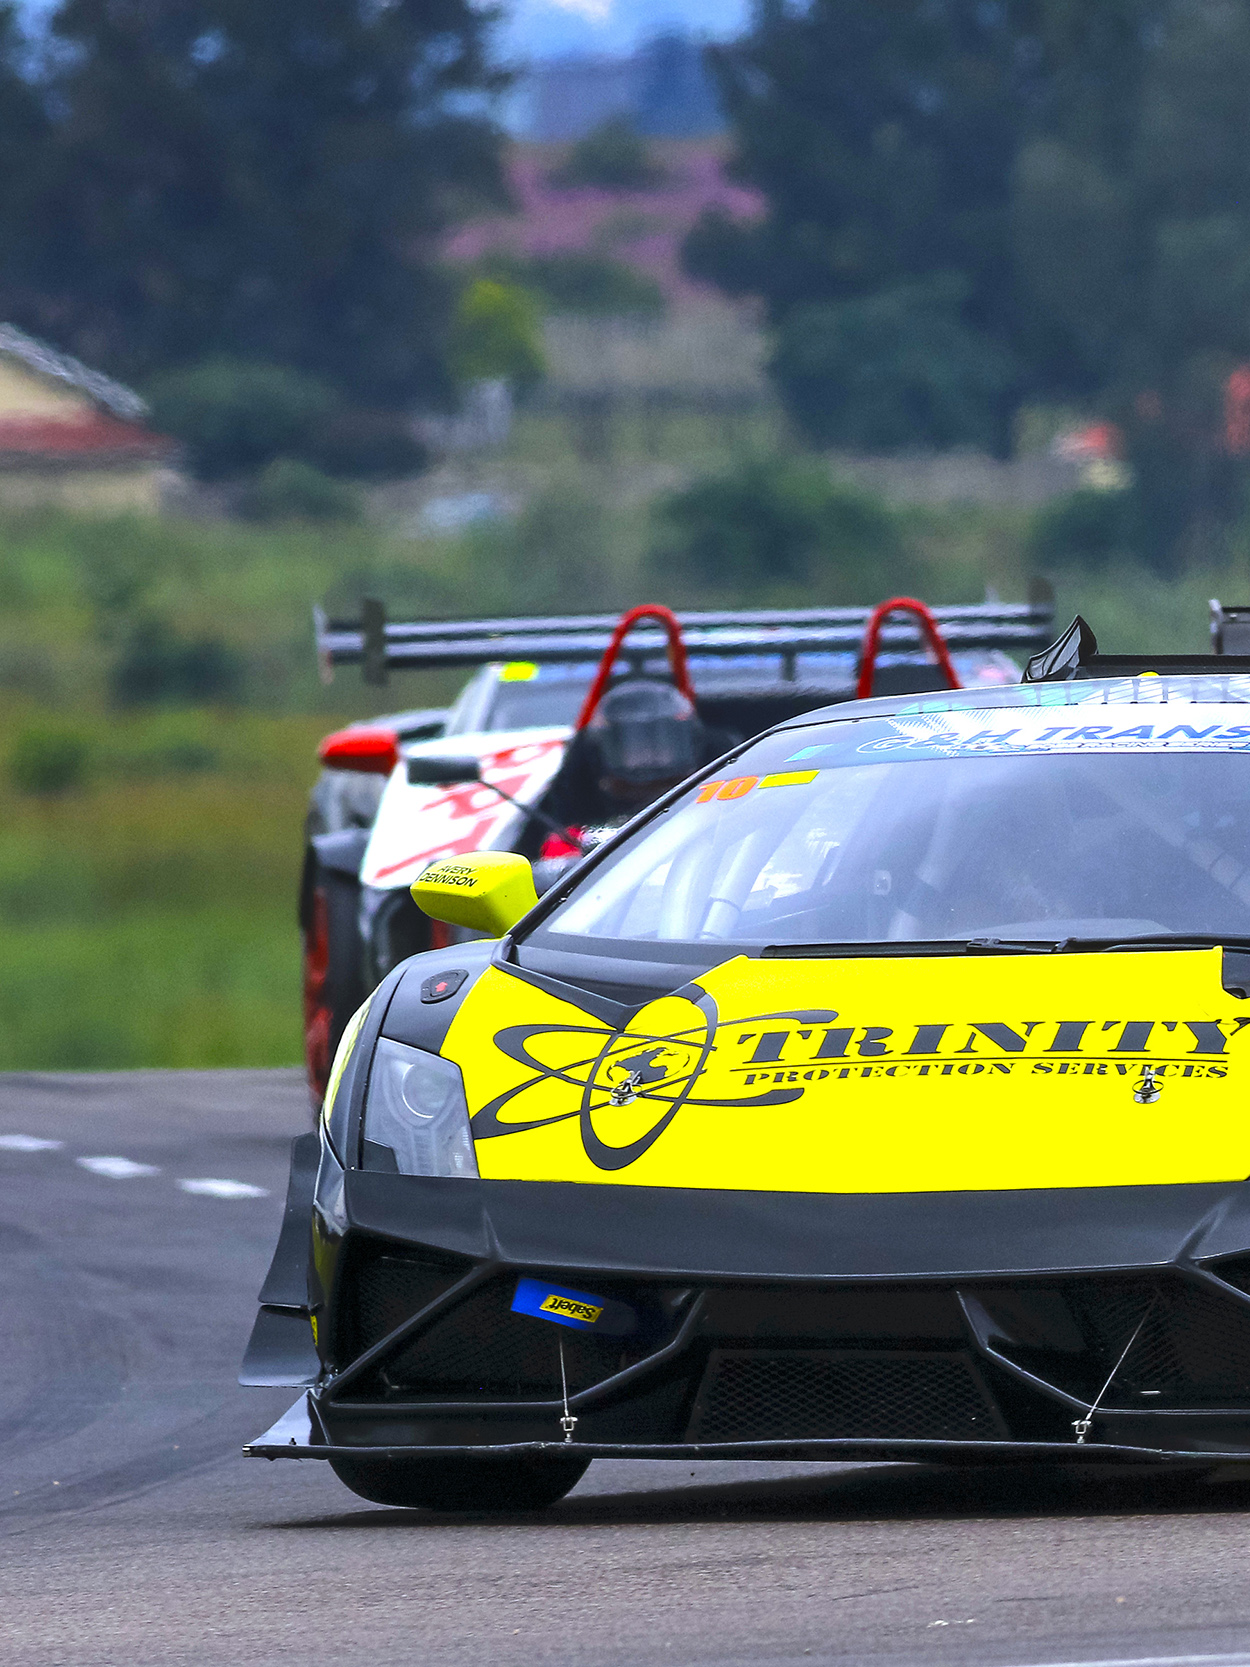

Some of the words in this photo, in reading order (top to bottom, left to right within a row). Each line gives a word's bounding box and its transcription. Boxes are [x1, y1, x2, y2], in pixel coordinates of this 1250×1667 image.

[695, 775, 759, 804] 10
[419, 872, 479, 888] DENNISON
[437, 865, 477, 875] AVERY
[744, 1061, 1016, 1085] PROTECTION
[1031, 1061, 1229, 1079] SERVICES
[549, 1297, 596, 1319] Sabelt
